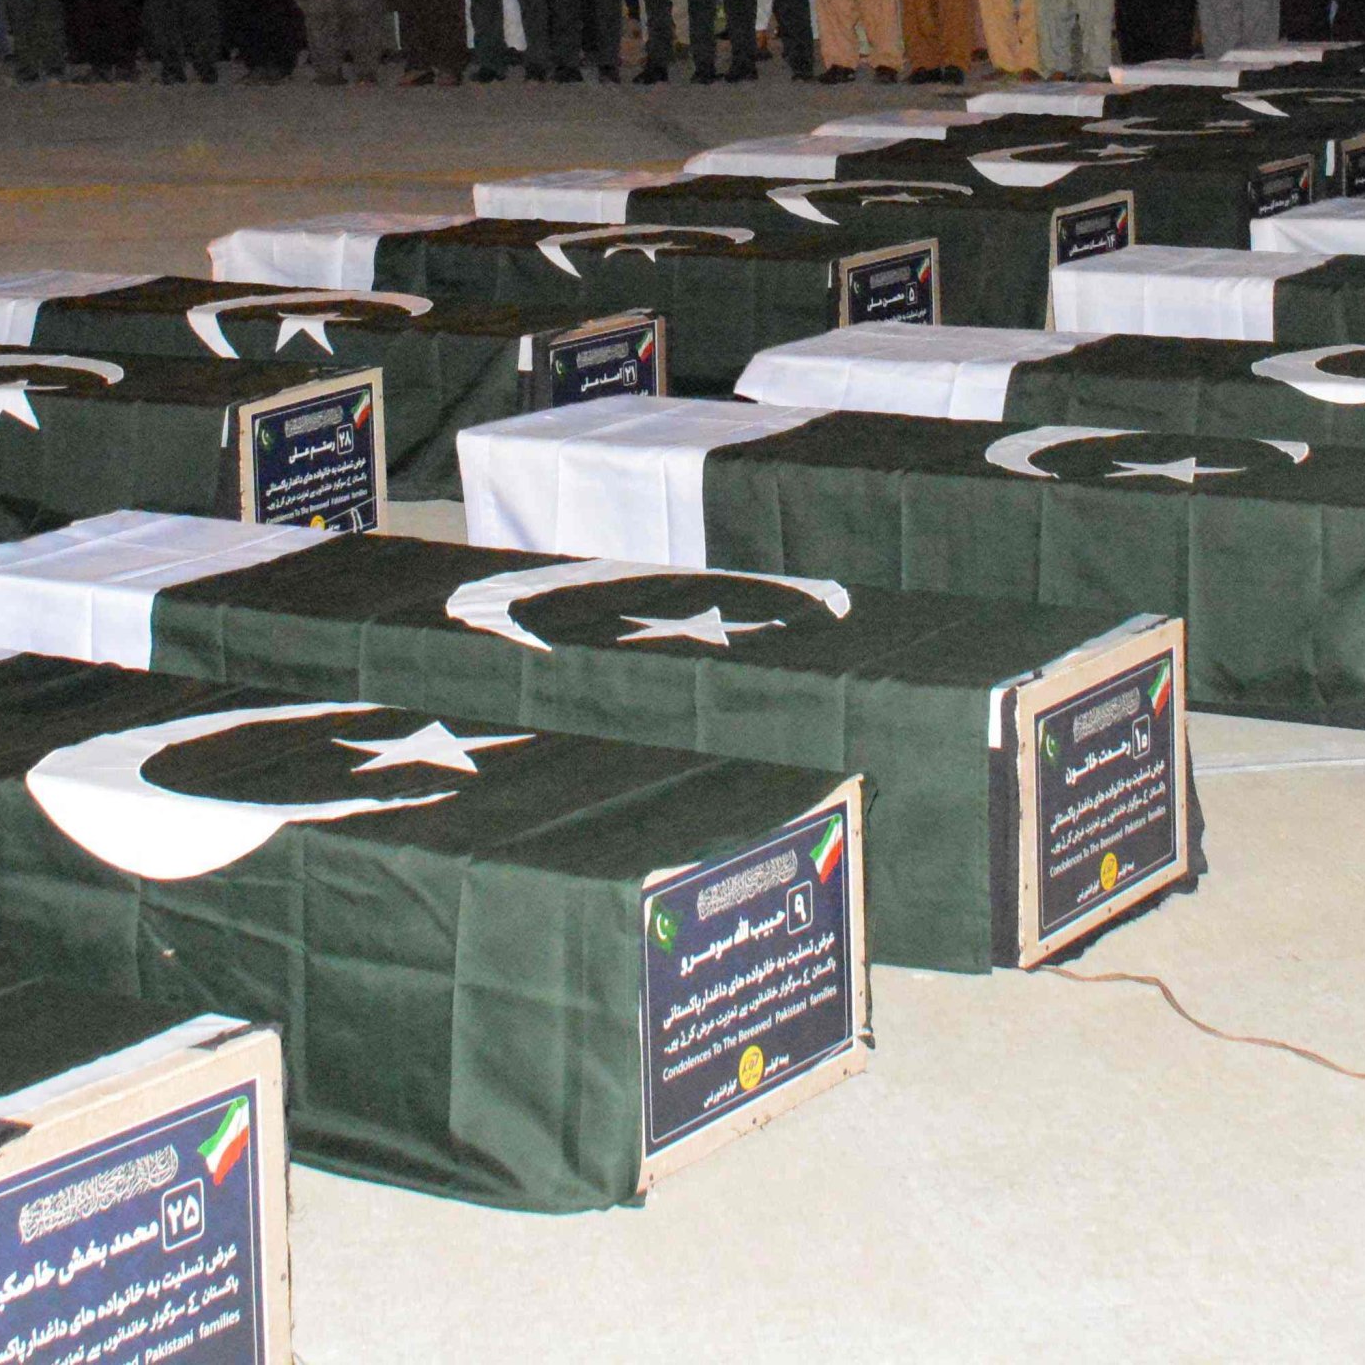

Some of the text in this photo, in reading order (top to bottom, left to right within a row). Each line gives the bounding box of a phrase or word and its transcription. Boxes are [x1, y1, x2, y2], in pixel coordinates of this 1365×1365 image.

[909, 287, 915, 302] ۵
[624, 366, 635, 382] ۲۱
[338, 431, 352, 447] ۲۸
[795, 894, 806, 922] ۹
[750, 910, 785, 940] حبیب
[663, 1048, 712, 1081] Condolences
[712, 1042, 722, 1055] To
[723, 1036, 737, 1050] The
[738, 1015, 772, 1043] Bereaved
[775, 998, 807, 1024] Pakistani
[810, 985, 837, 1006] families
[167, 1195, 200, 1235] ۲۵
[110, 1221, 159, 1255] محمد
[58, 1240, 107, 1285] بخش
[162, 1255, 204, 1290] تسلیت
[205, 1243, 237, 1275] عرض
[97, 1282, 145, 1319] خانواده
[146, 1280, 161, 1299] به
[202, 1275, 239, 1306] پاکستان
[69, 1306, 96, 1336] های
[147, 1300, 185, 1332] سوگوار
[26, 1318, 68, 1358] داغدار
[145, 1309, 240, 1365] Pakistani families
